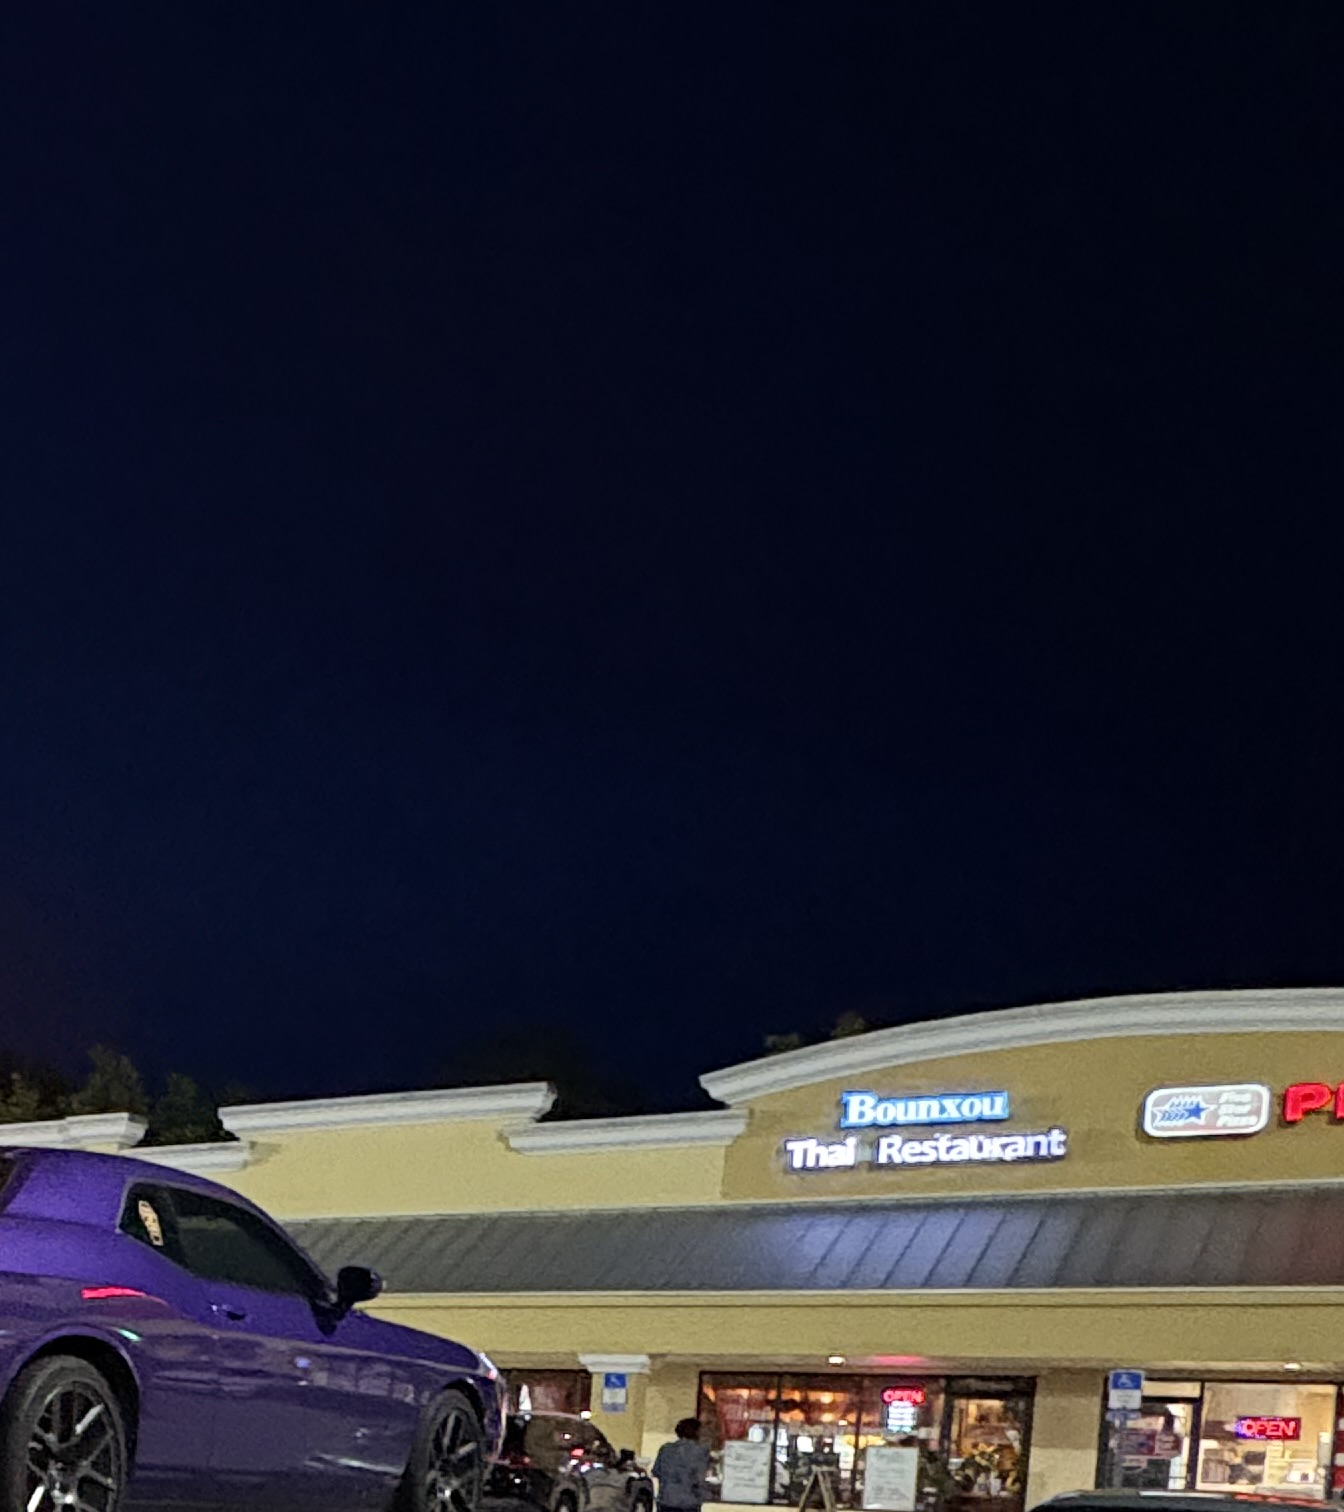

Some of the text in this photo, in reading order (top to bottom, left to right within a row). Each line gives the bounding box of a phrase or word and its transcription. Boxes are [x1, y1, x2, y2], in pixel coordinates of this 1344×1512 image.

[841, 1090, 1009, 1128] Bounxou
[786, 1128, 1067, 1169] Thai Restaurant
[882, 1389, 926, 1404] OPEN
[1241, 1419, 1297, 1437] OPEN
